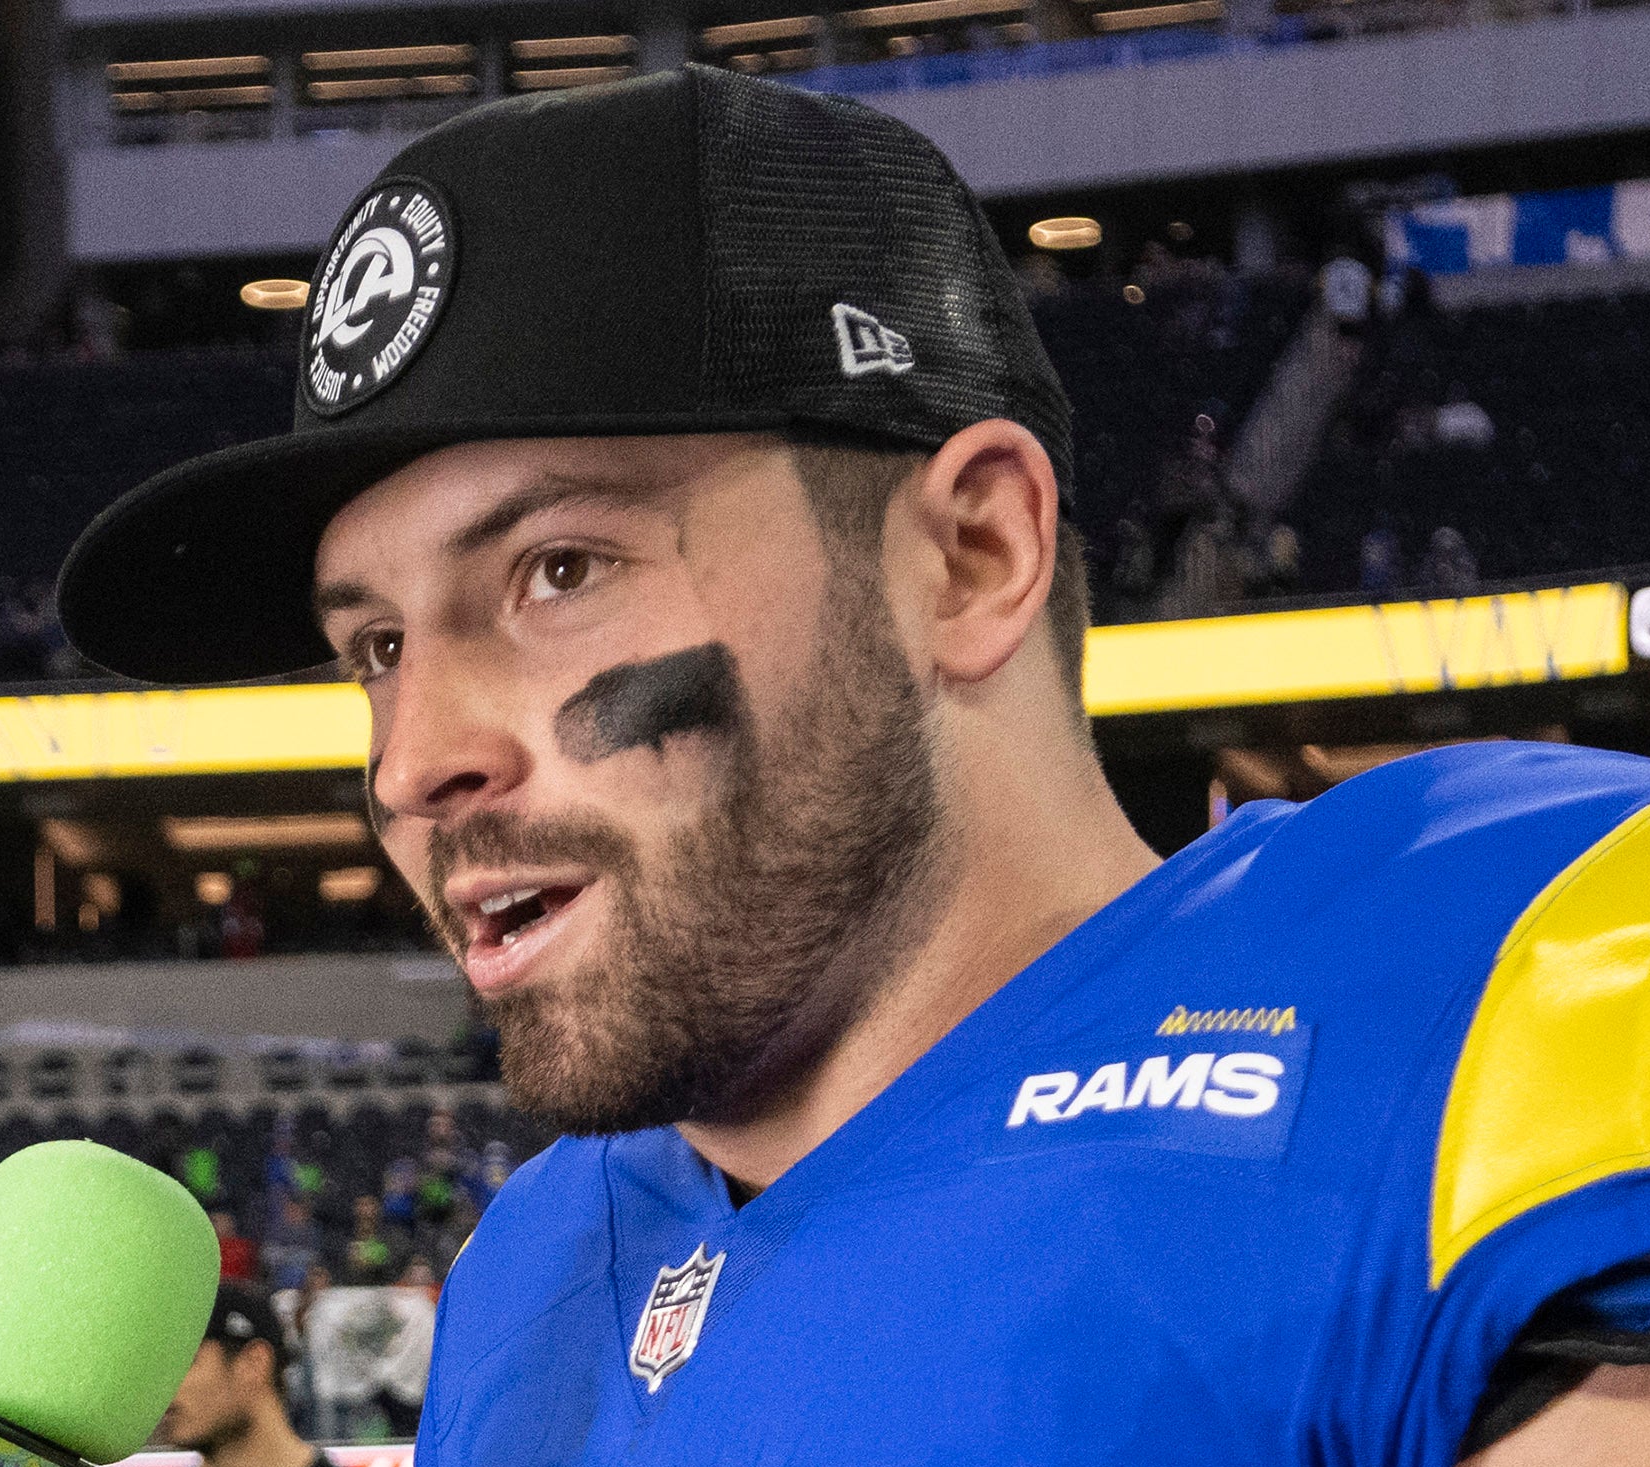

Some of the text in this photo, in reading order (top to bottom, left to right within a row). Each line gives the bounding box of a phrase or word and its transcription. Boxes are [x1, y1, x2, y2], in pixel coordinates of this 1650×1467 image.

[312, 193, 383, 320] OPPORTUNITY
[401, 193, 445, 253] EQUITY
[372, 286, 440, 381] FREEDOM
[310, 347, 347, 401] JUSTICE
[1005, 1052, 1286, 1127] RAMS
[640, 1304, 691, 1360] NFL
